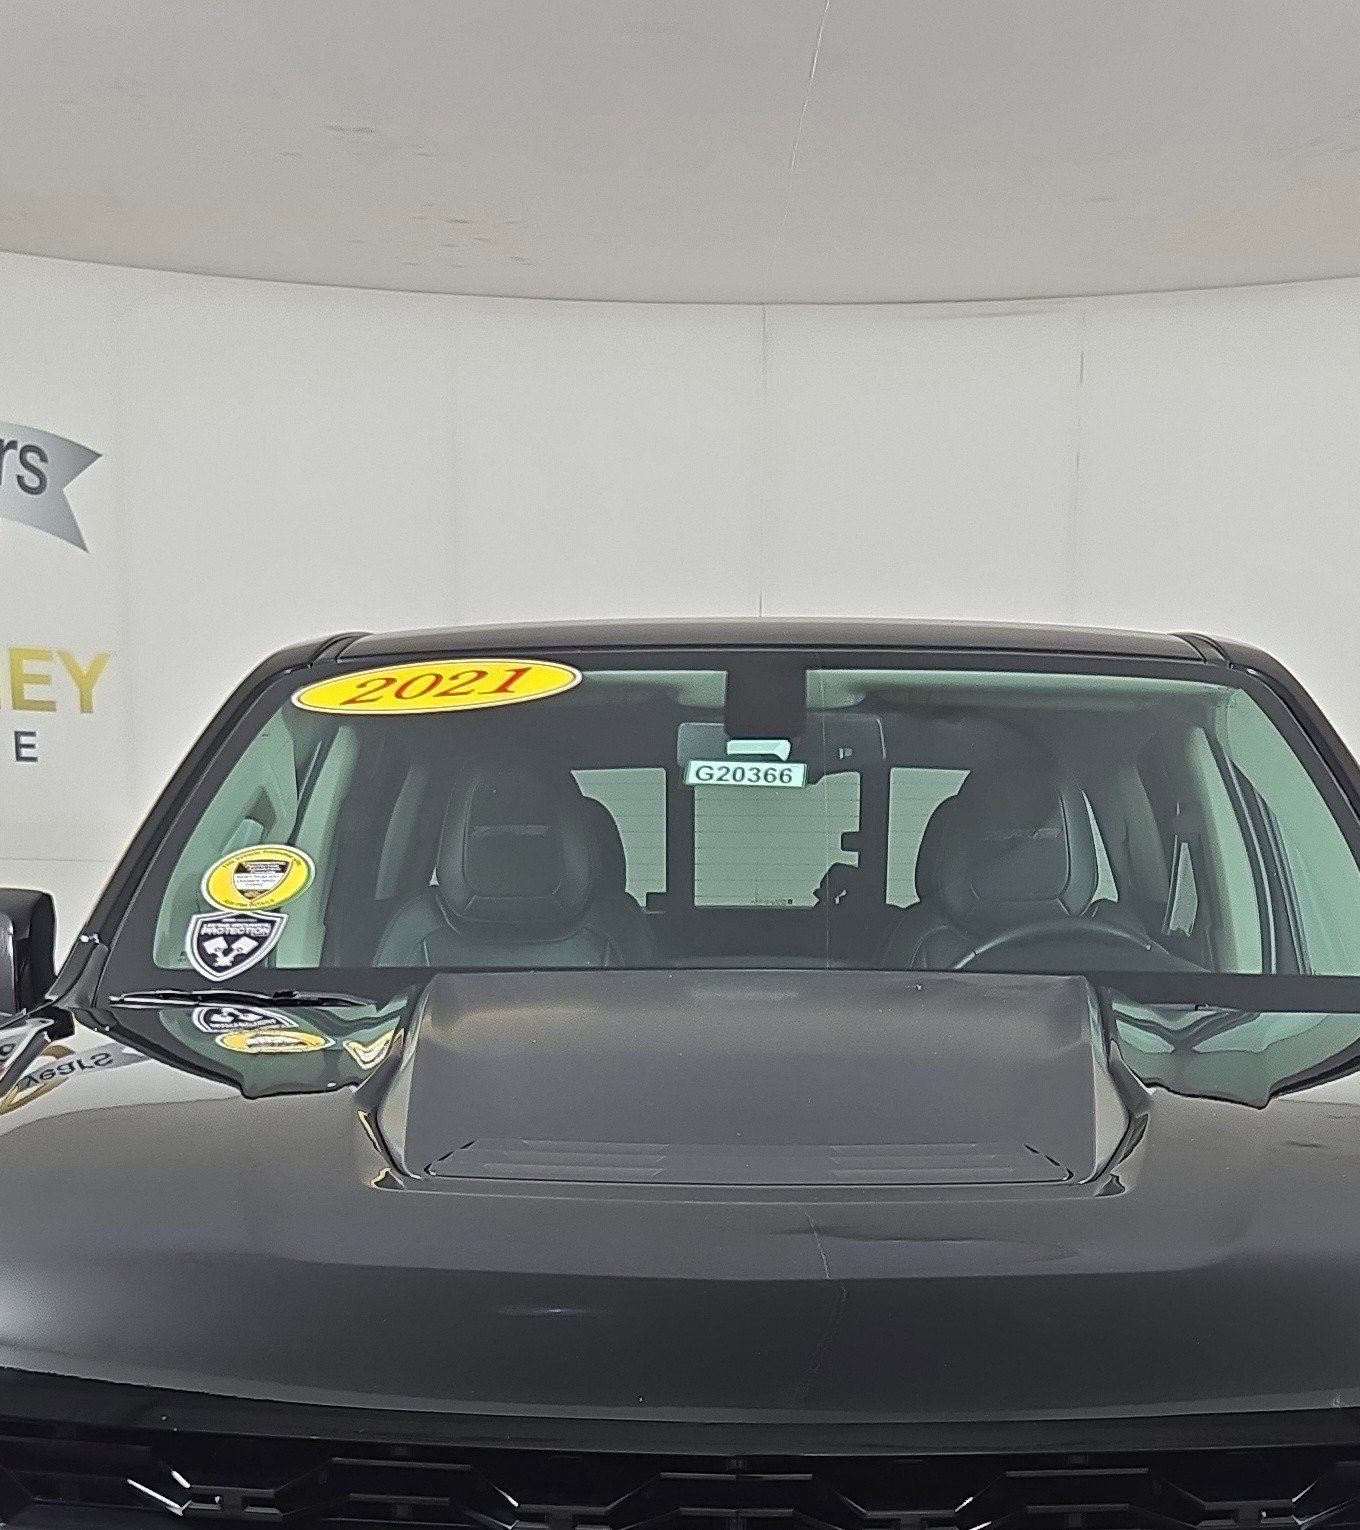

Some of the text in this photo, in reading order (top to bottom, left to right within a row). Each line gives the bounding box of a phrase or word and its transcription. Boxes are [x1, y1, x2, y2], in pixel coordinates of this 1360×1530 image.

[339, 665, 526, 708] 2021
[694, 763, 794, 787] G20366
[201, 925, 270, 936] PROTECTION
